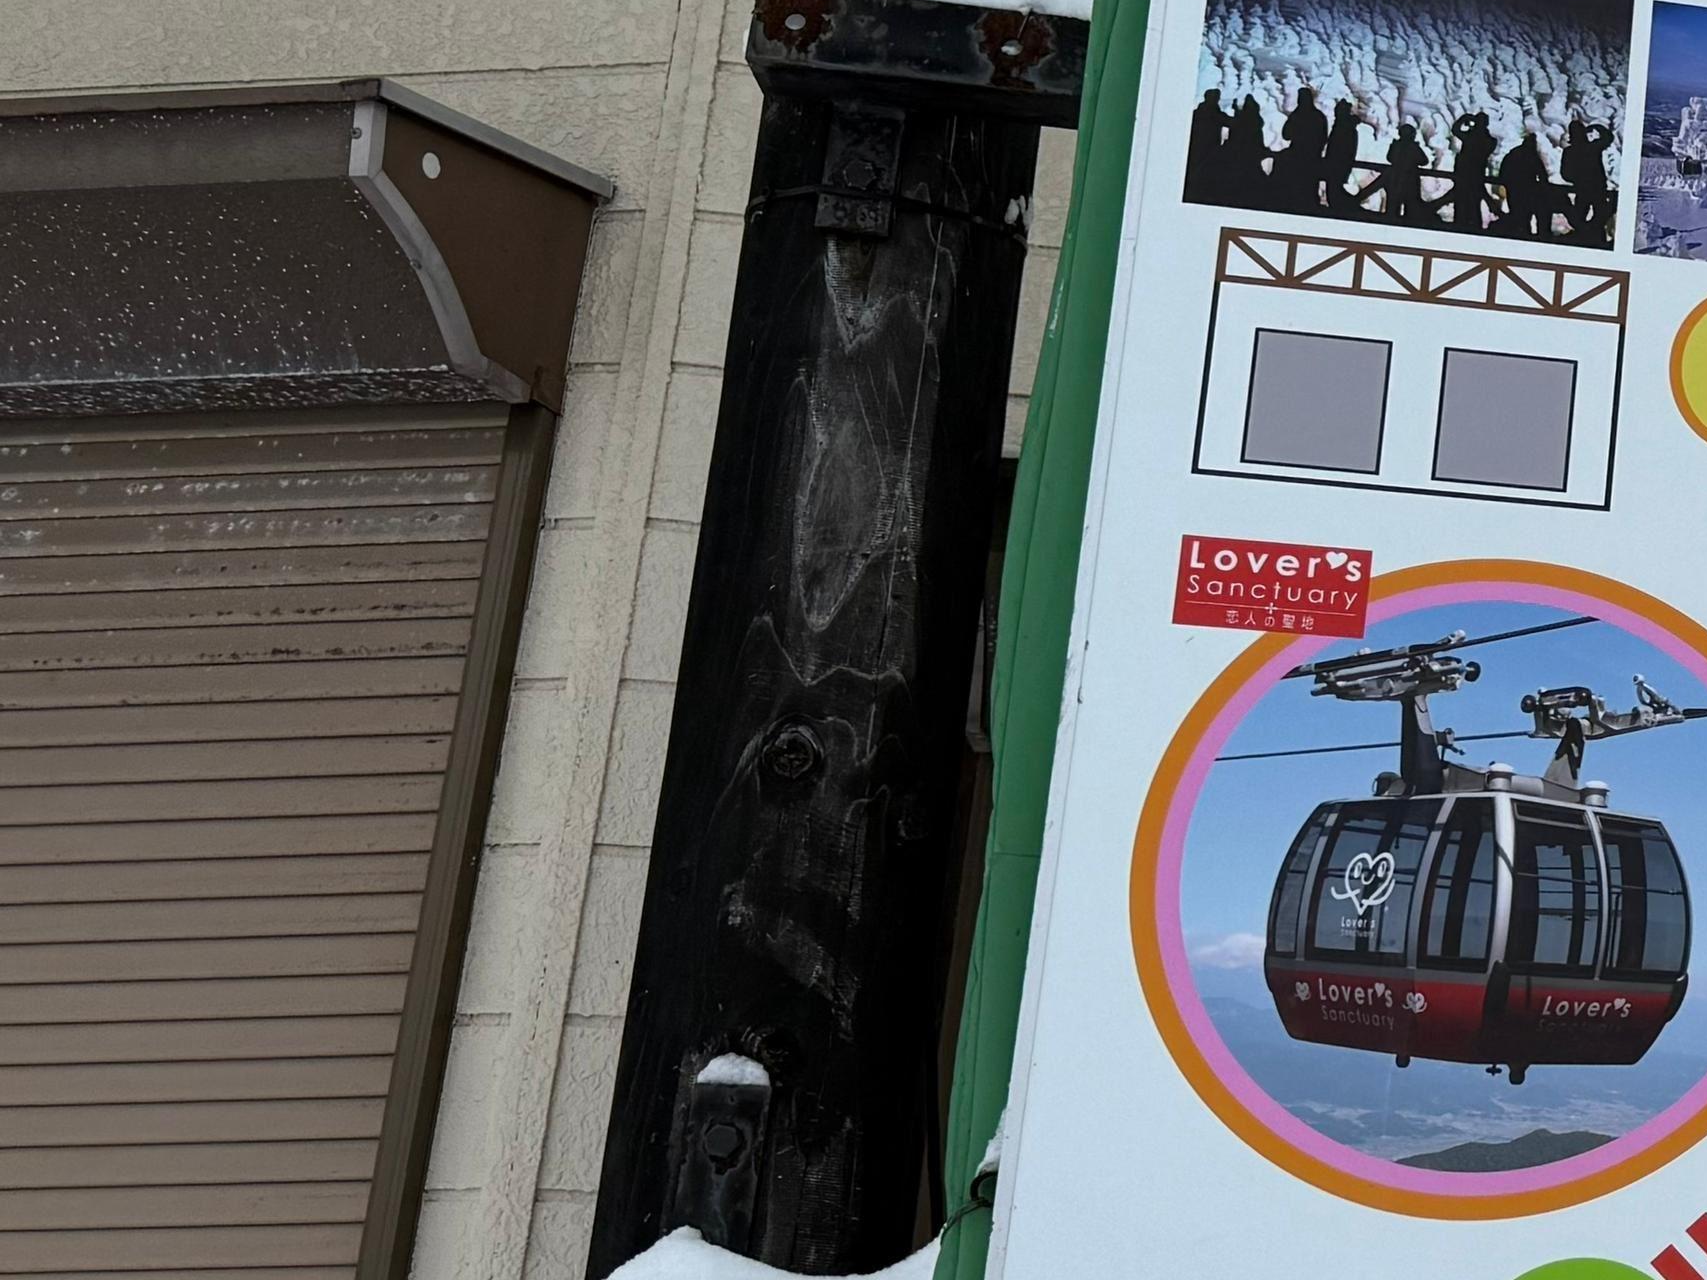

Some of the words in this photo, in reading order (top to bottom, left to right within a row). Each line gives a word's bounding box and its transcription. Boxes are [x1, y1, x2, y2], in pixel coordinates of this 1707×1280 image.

[1187, 575, 1358, 610] Sanctuary
[1225, 610, 1316, 630] 恋人の聖地
[1341, 916, 1375, 929] Lovers
[1321, 1004, 1395, 1031] Sanctuary
